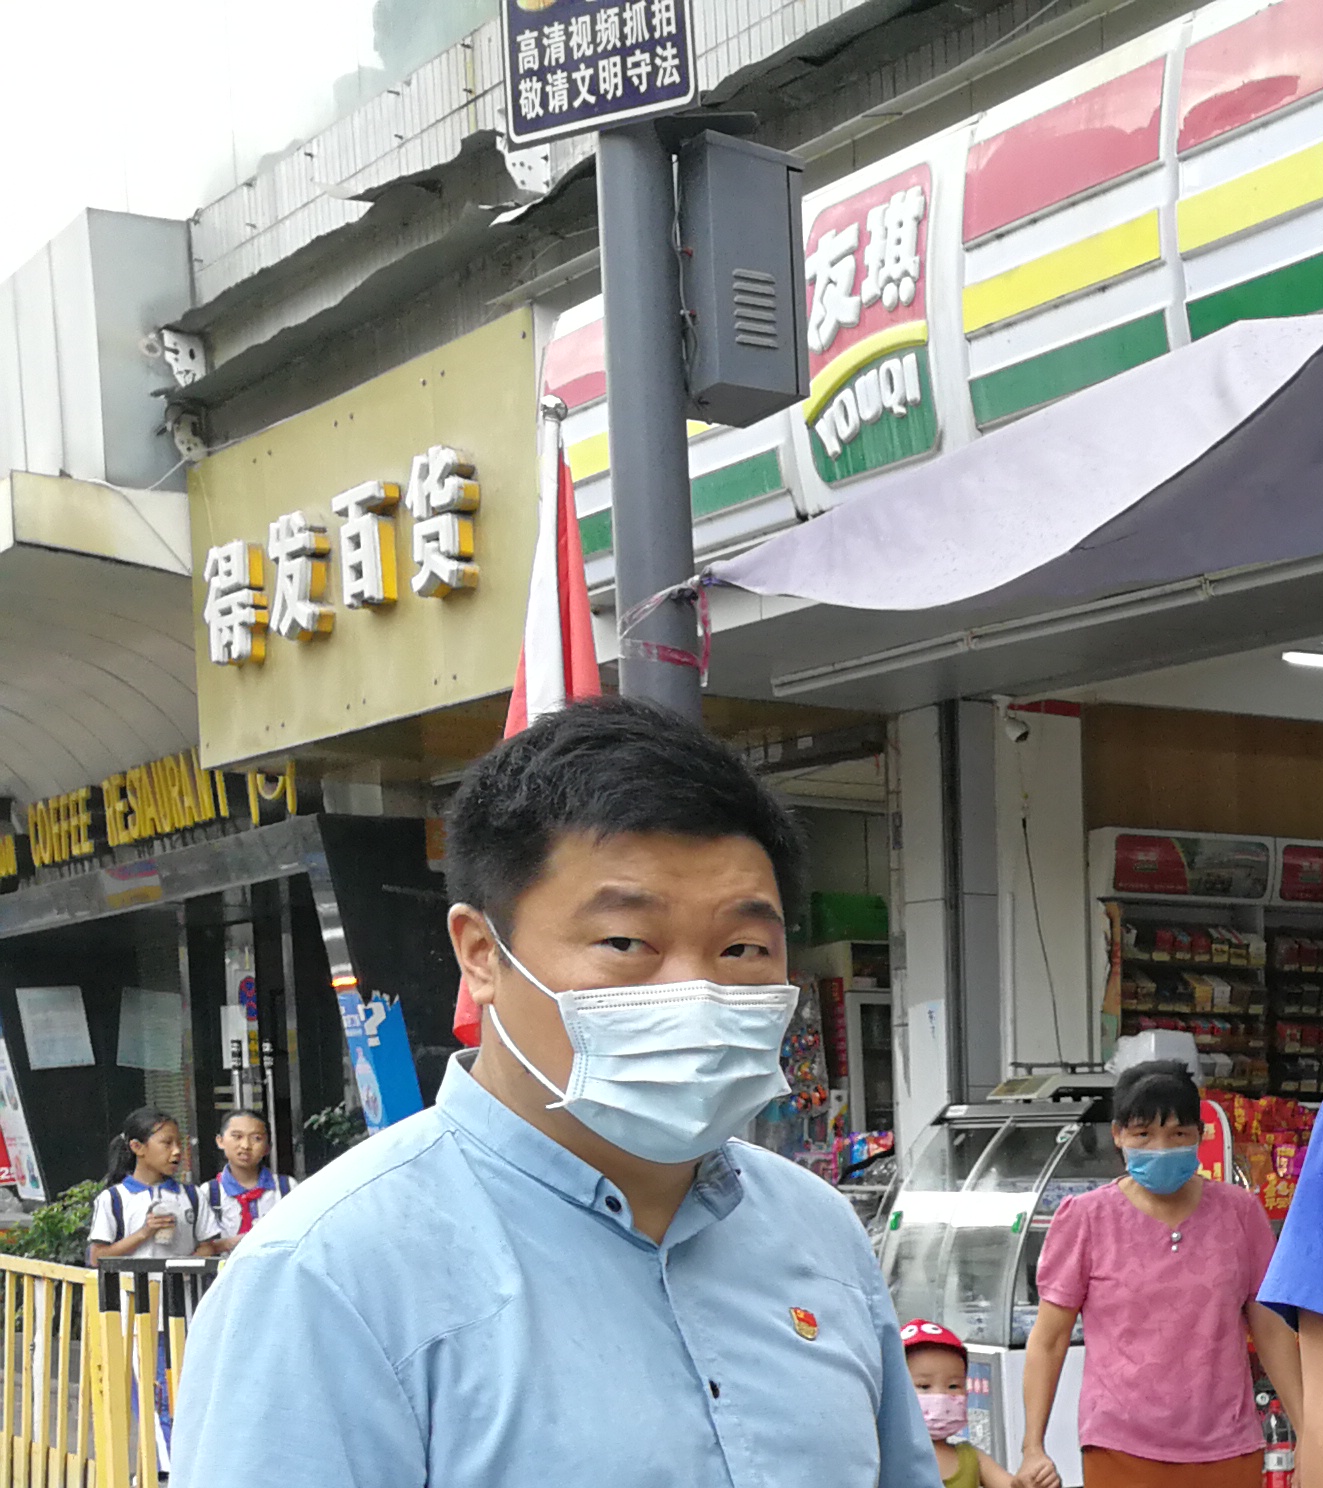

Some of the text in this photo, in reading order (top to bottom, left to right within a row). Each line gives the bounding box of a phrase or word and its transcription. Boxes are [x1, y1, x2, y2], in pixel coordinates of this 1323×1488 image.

[516, 0, 677, 74] 高清视频抓拍
[518, 41, 682, 120] 敬请文明守法
[805, 186, 926, 355] 友琪
[815, 353, 922, 461] YOUQI
[204, 445, 480, 666] 得发百货
[28, 786, 95, 868] COFFEE
